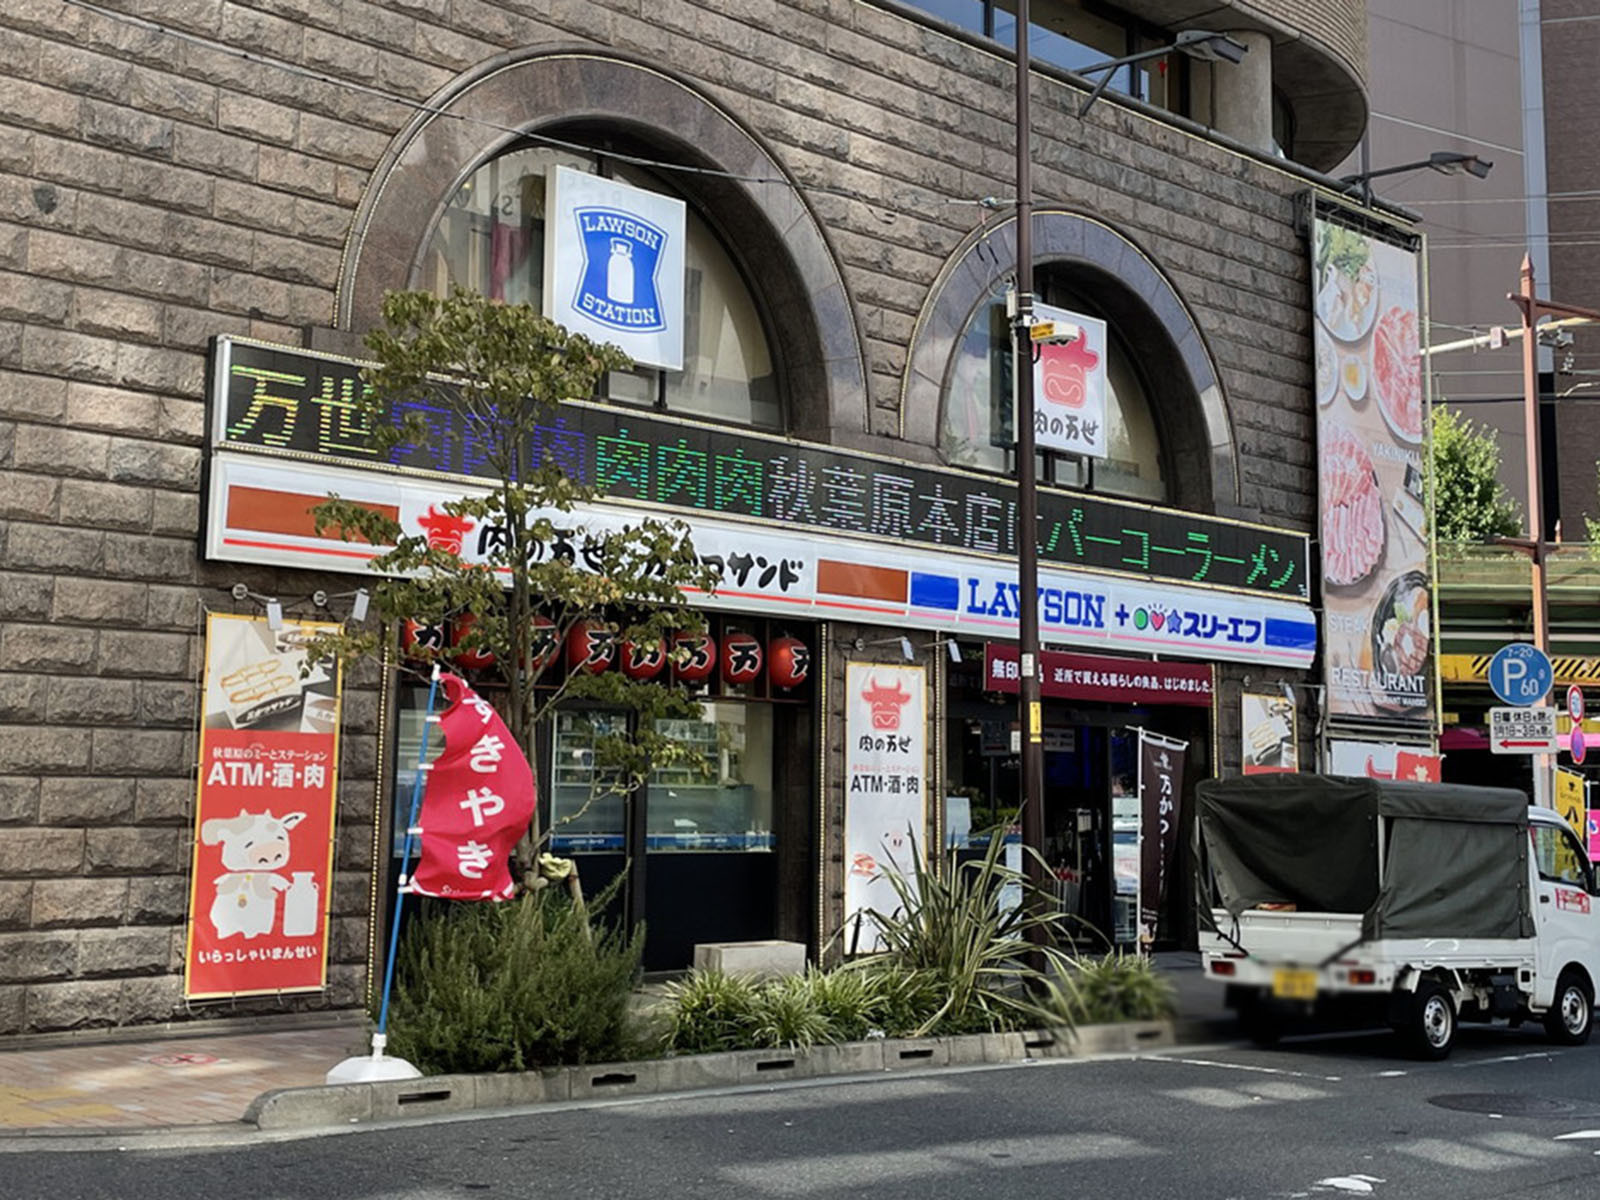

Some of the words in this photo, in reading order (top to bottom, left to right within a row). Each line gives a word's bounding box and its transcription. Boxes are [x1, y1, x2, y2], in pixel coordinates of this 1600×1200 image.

[583, 214, 660, 251] LAWSON
[582, 293, 657, 325] STATION
[1184, 611, 1263, 643] スリーエフ
[728, 642, 761, 675] 万
[1331, 667, 1425, 692] RESTAURANT
[459, 693, 505, 880] すきやき
